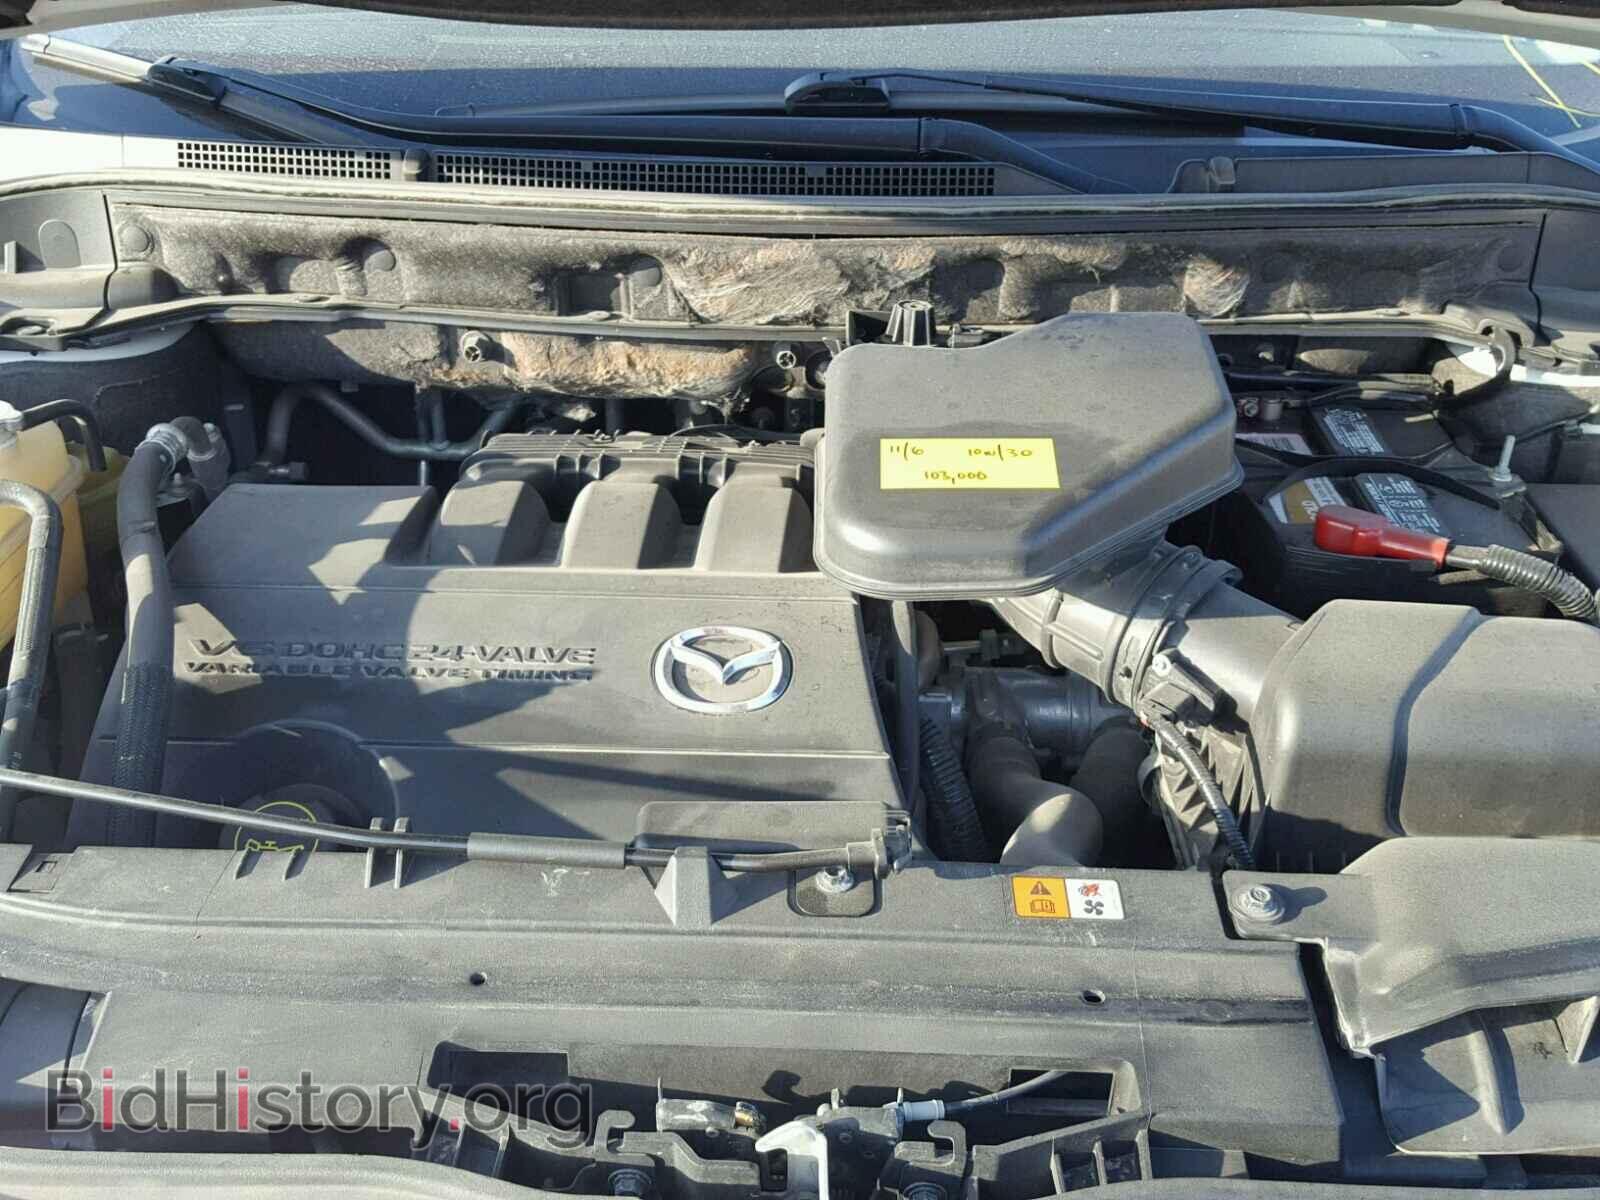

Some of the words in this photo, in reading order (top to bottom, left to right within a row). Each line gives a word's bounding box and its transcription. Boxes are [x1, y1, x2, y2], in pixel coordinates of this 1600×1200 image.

[282, 641, 405, 660] DOHC
[186, 661, 352, 678] VARIABLE
[361, 664, 471, 680] VALVE
[480, 667, 594, 681] TIMING
